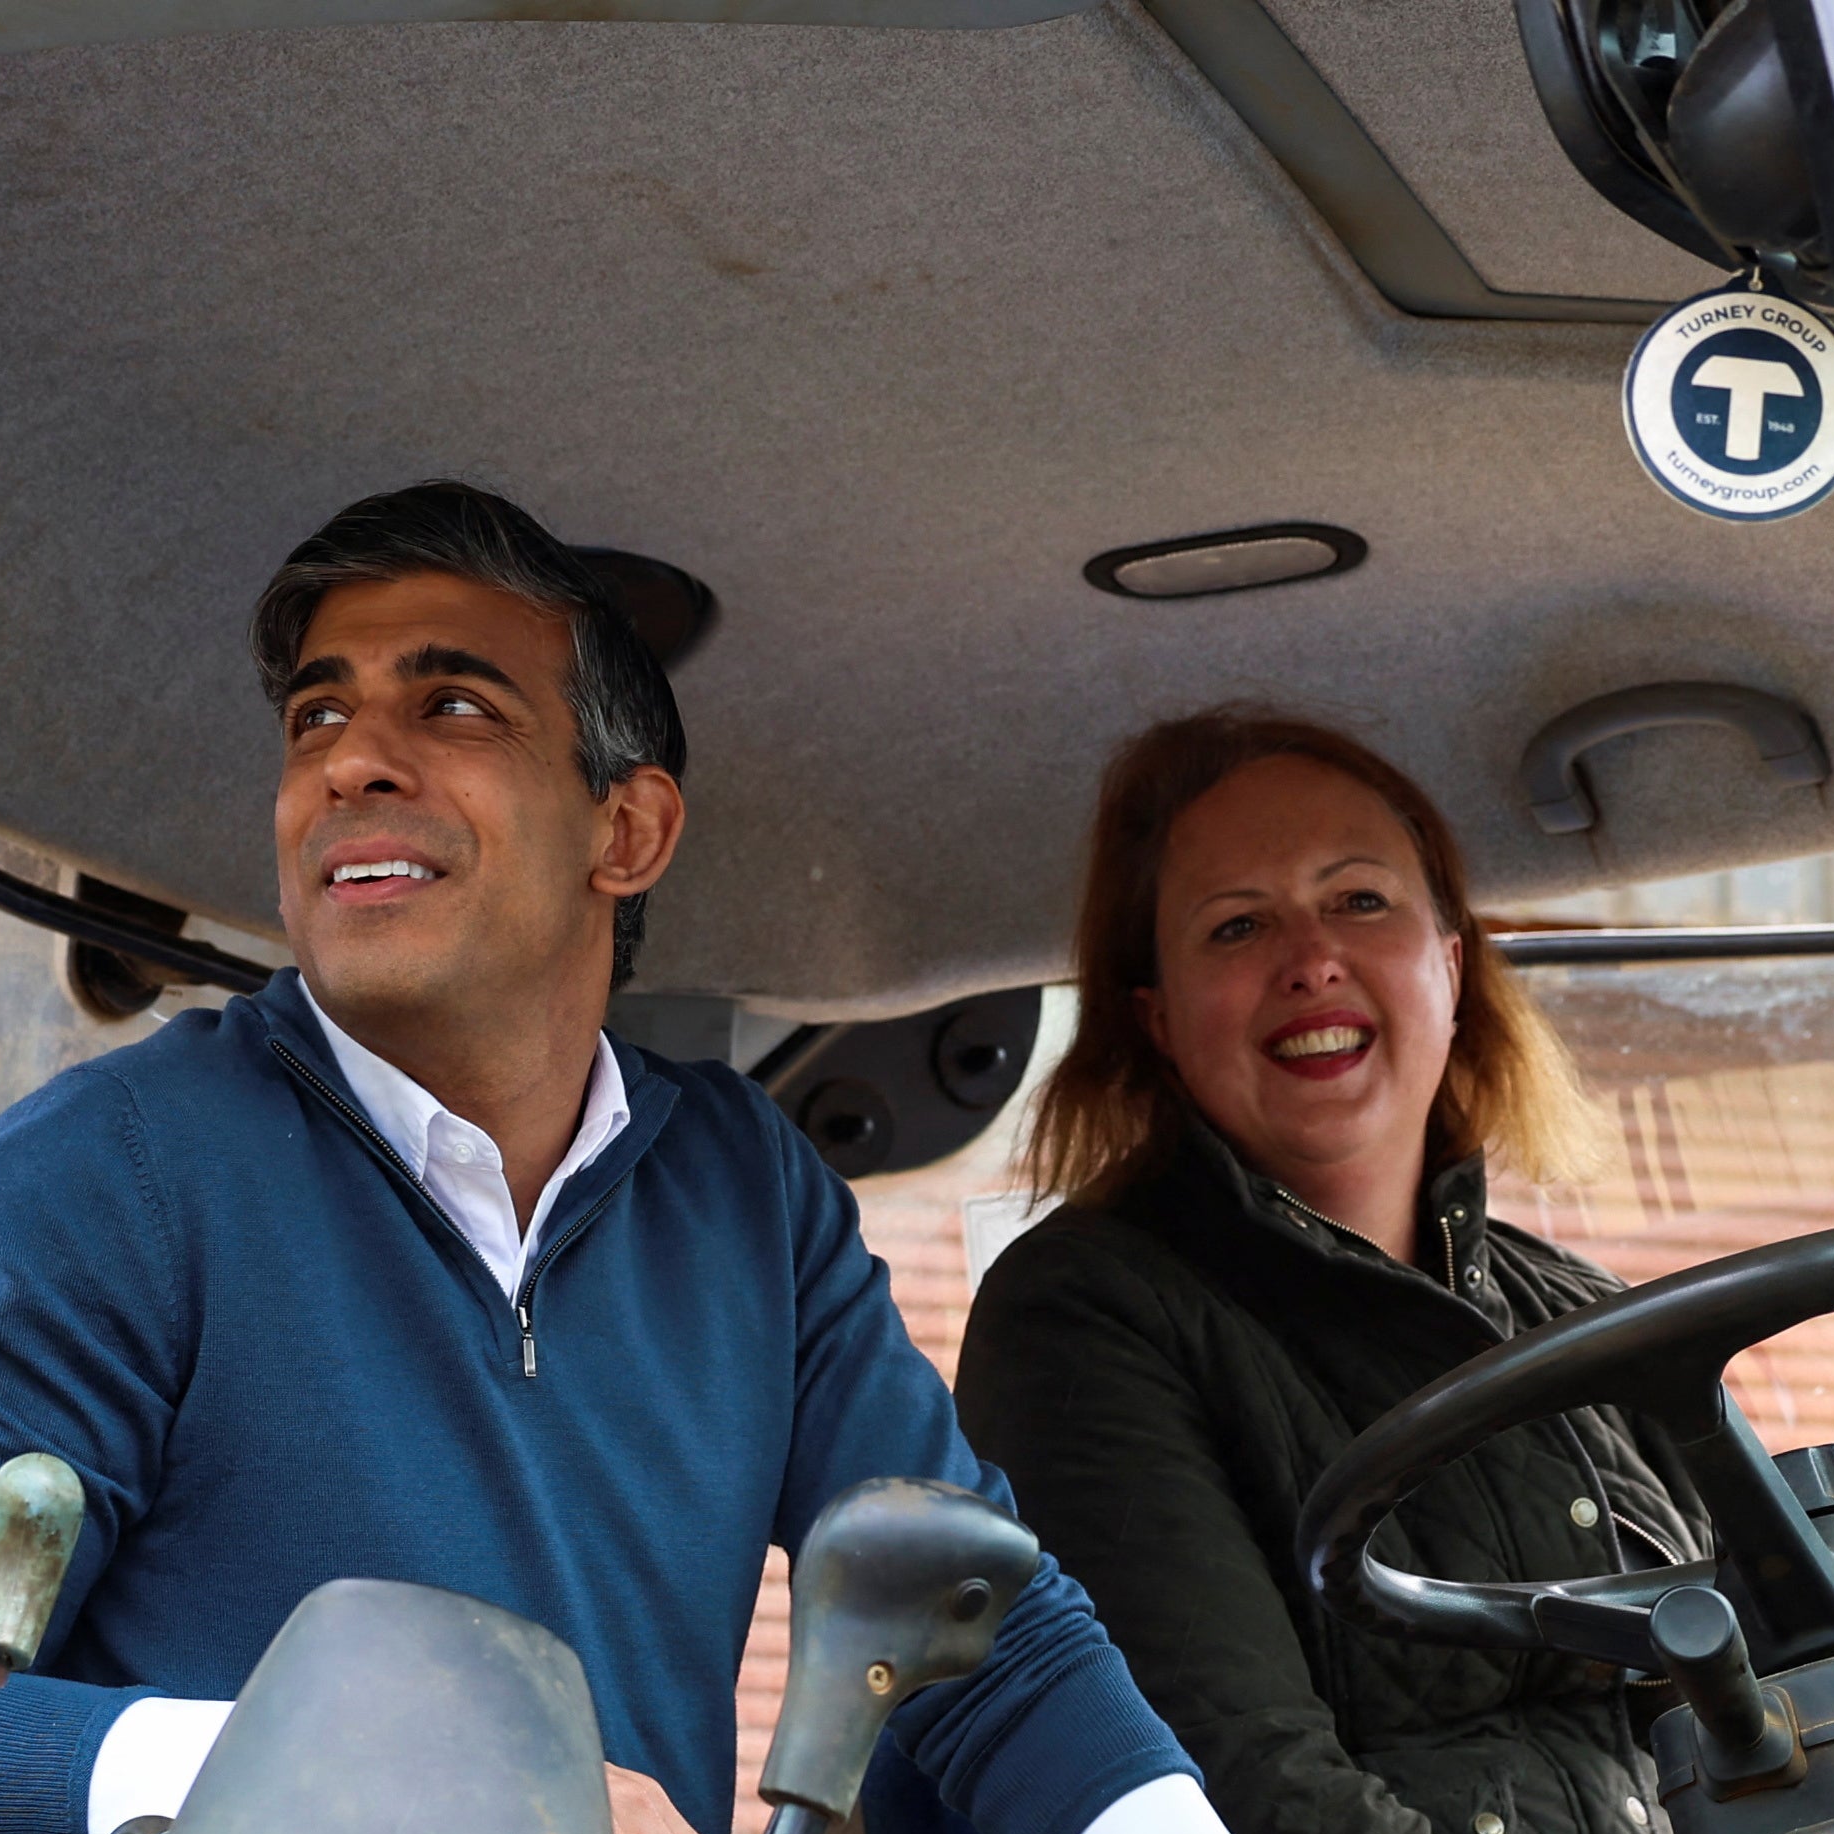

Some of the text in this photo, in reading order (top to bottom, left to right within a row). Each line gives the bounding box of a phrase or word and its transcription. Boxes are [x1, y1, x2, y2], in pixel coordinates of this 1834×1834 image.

[1675, 305, 1827, 352] TURNEY GROUP
[1690, 354, 1806, 461] T
[1695, 412, 1721, 425] EST.
[1667, 450, 1822, 500] turneygroup.com
